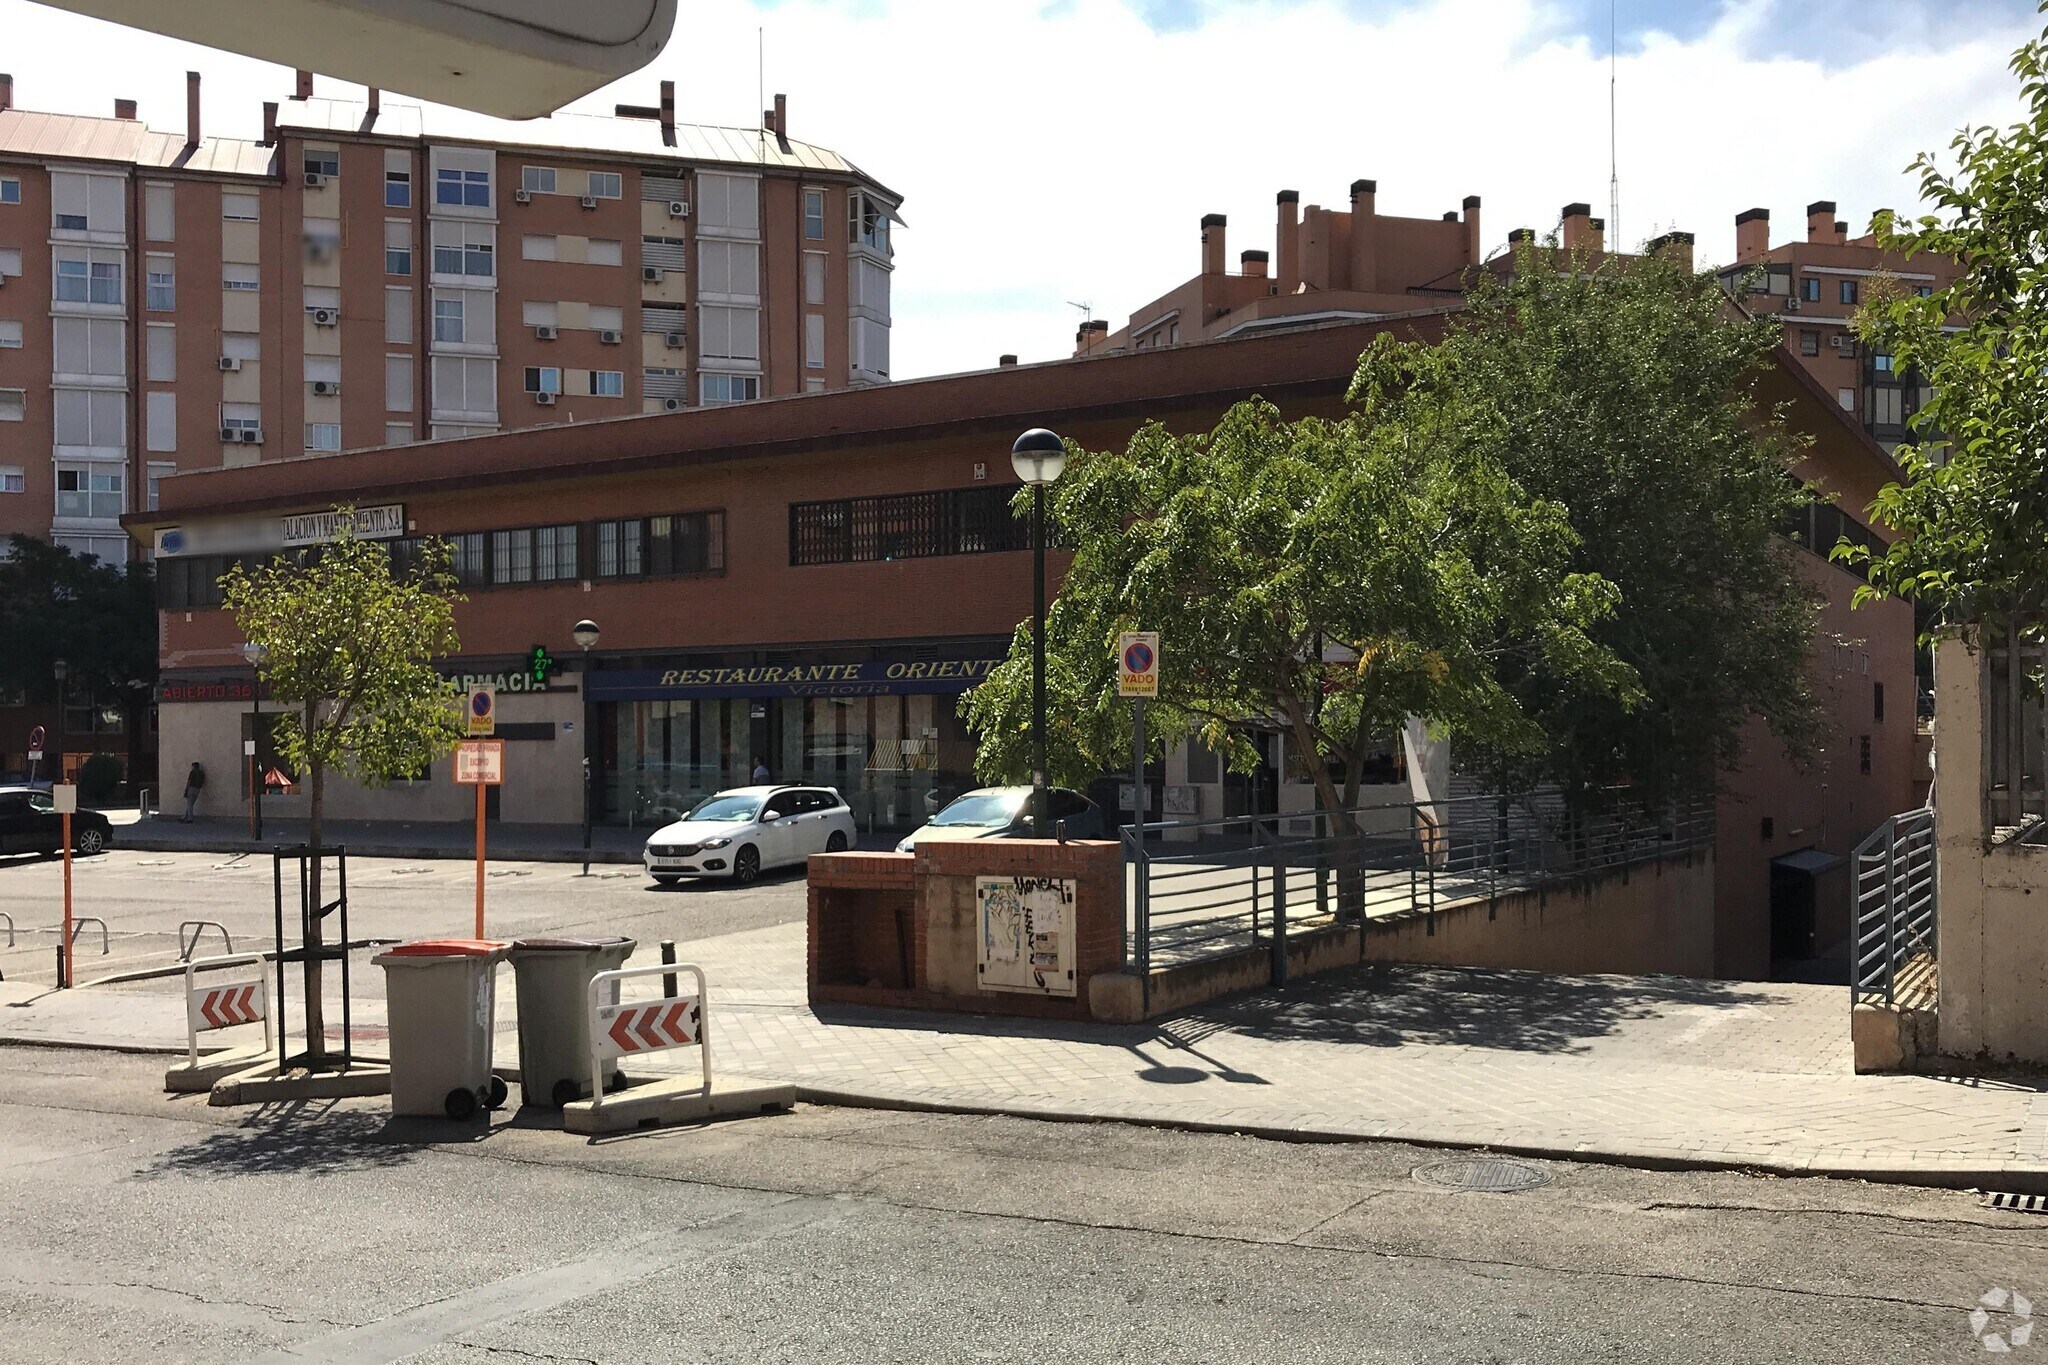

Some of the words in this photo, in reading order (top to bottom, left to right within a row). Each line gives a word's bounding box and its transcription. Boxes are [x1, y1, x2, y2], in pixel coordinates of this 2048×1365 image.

[316, 516, 322, 537] Y
[660, 663, 863, 686] RESTAURANTE
[1123, 674, 1154, 684] VADO
[163, 685, 226, 699] ABIERTO
[787, 683, 891, 695] Victoria
[471, 716, 492, 725] VADO
